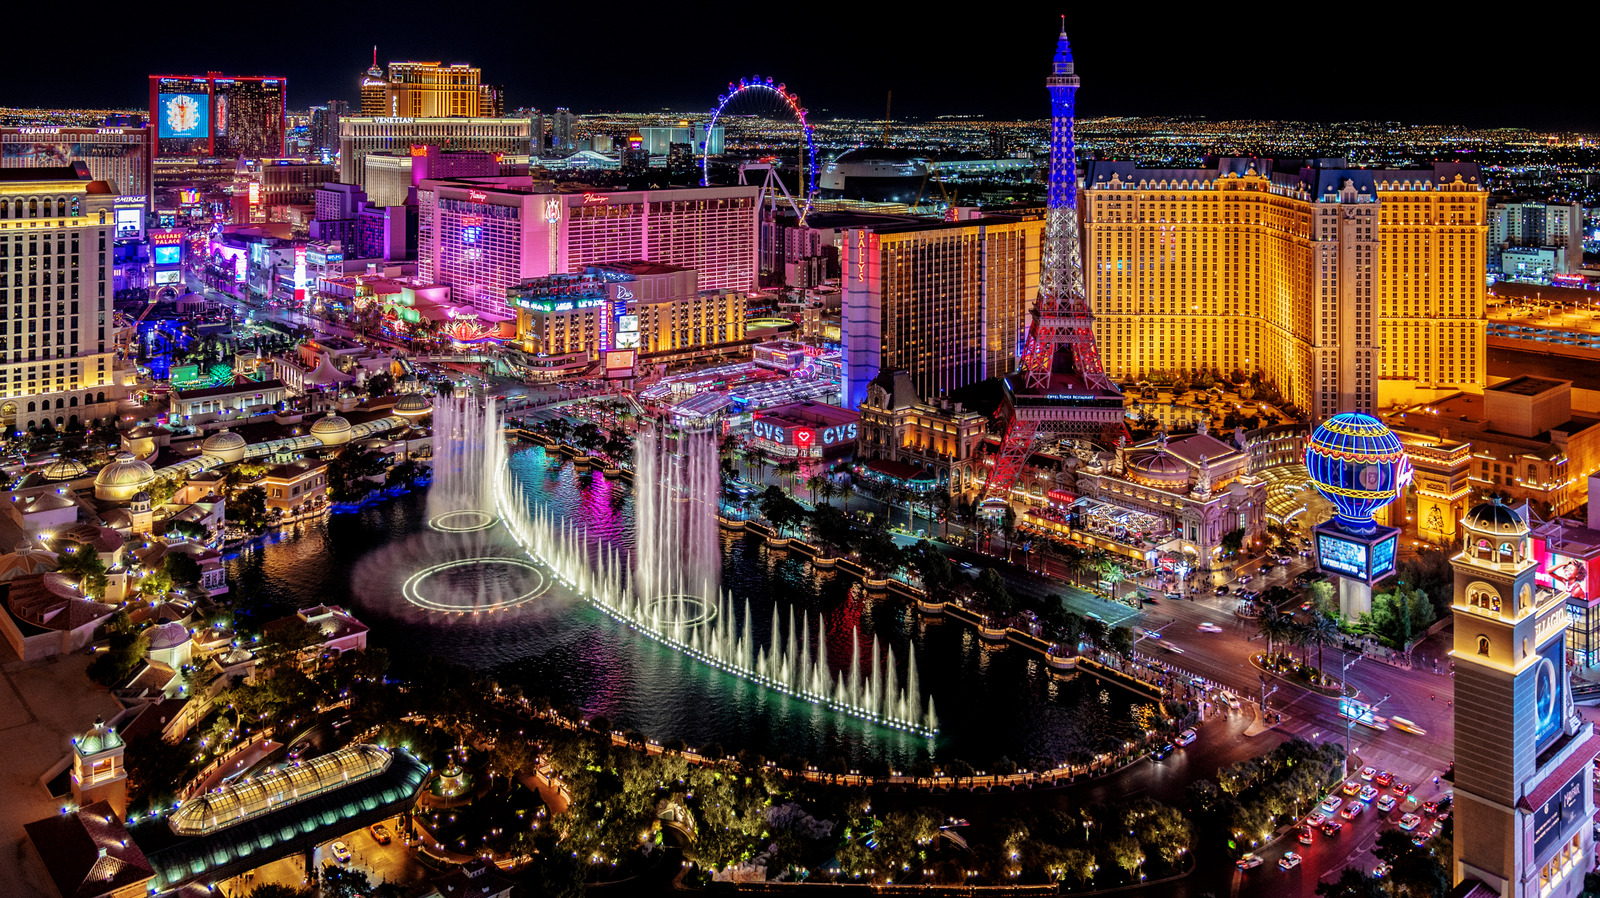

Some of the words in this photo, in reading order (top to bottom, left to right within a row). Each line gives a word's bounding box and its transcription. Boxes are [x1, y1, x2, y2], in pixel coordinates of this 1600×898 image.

[469, 189, 488, 202] Flamingo
[583, 193, 609, 204] Flamingo
[753, 420, 784, 443] CVS
[823, 423, 857, 445] CVS
[1060, 495, 1073, 503] PARK
